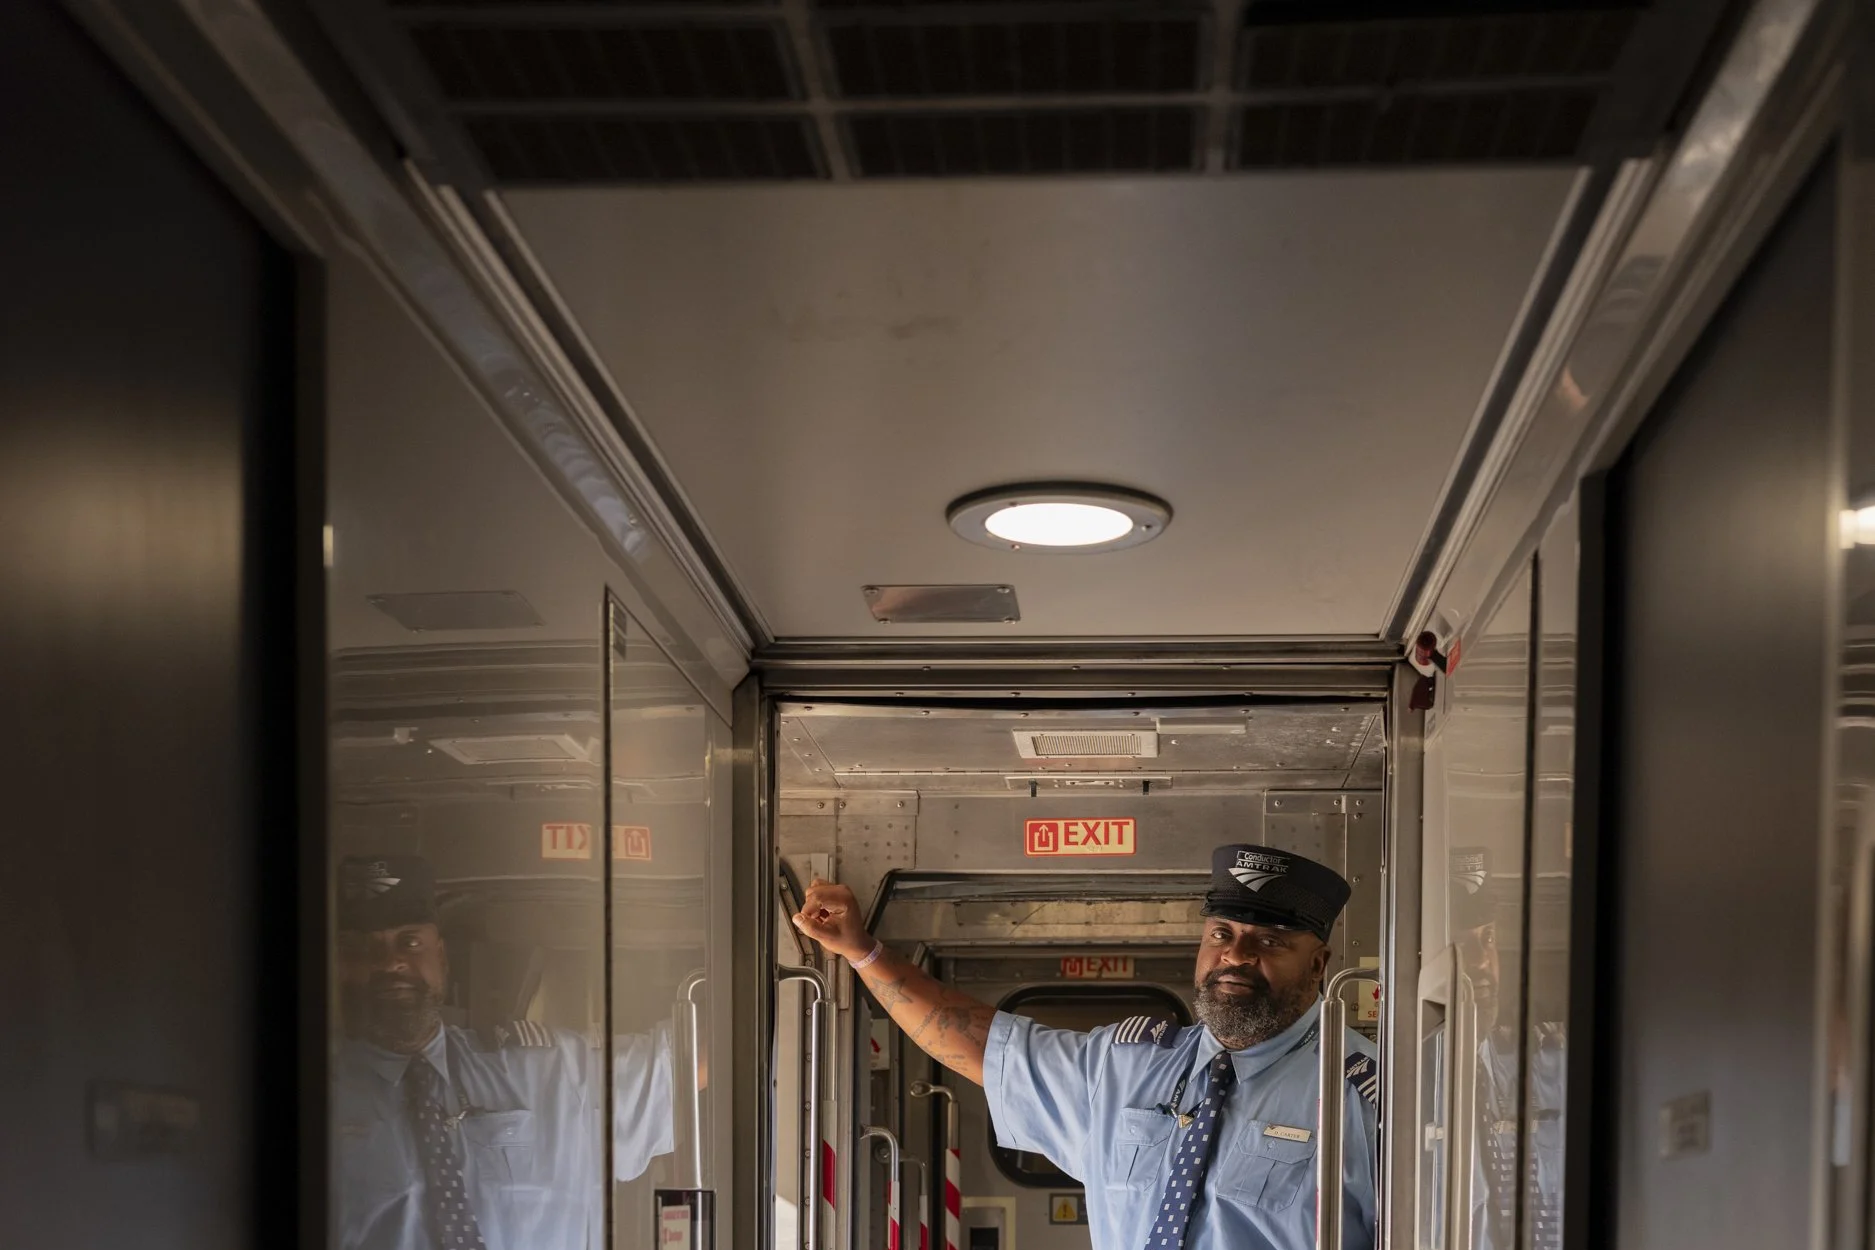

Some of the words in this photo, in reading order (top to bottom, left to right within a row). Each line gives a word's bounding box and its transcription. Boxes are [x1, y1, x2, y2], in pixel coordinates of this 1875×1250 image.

[1063, 821, 1130, 846] EXIT
[1244, 852, 1281, 864] Conductor
[1236, 860, 1288, 873] AMTRAK
[1086, 956, 1128, 973] EXIT
